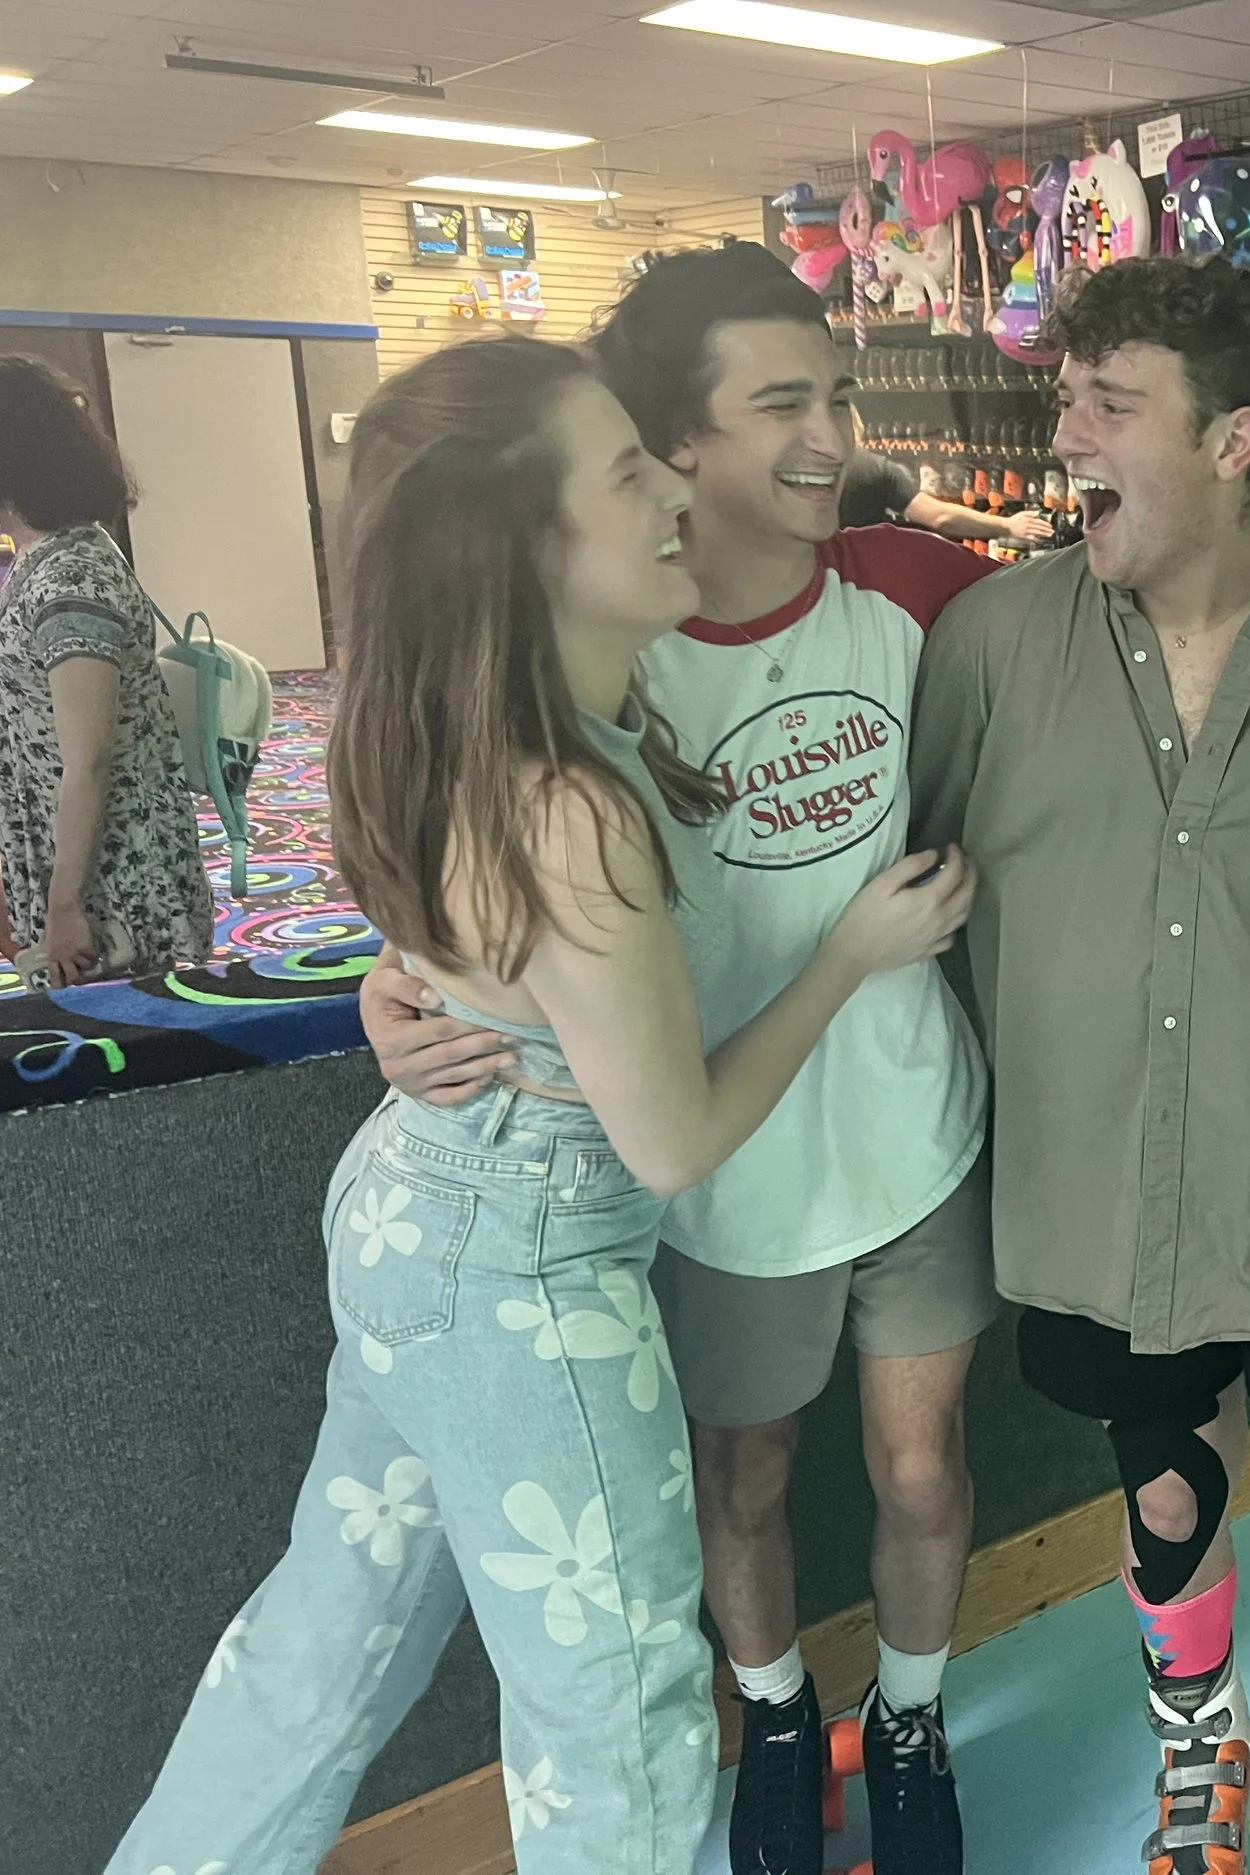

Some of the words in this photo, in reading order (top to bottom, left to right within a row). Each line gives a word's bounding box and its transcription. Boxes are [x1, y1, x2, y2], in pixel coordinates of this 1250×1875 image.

[777, 709, 808, 732] 125
[715, 710, 889, 802] Louisville
[795, 840, 834, 857] Kentucky
[834, 828, 857, 843] Made
